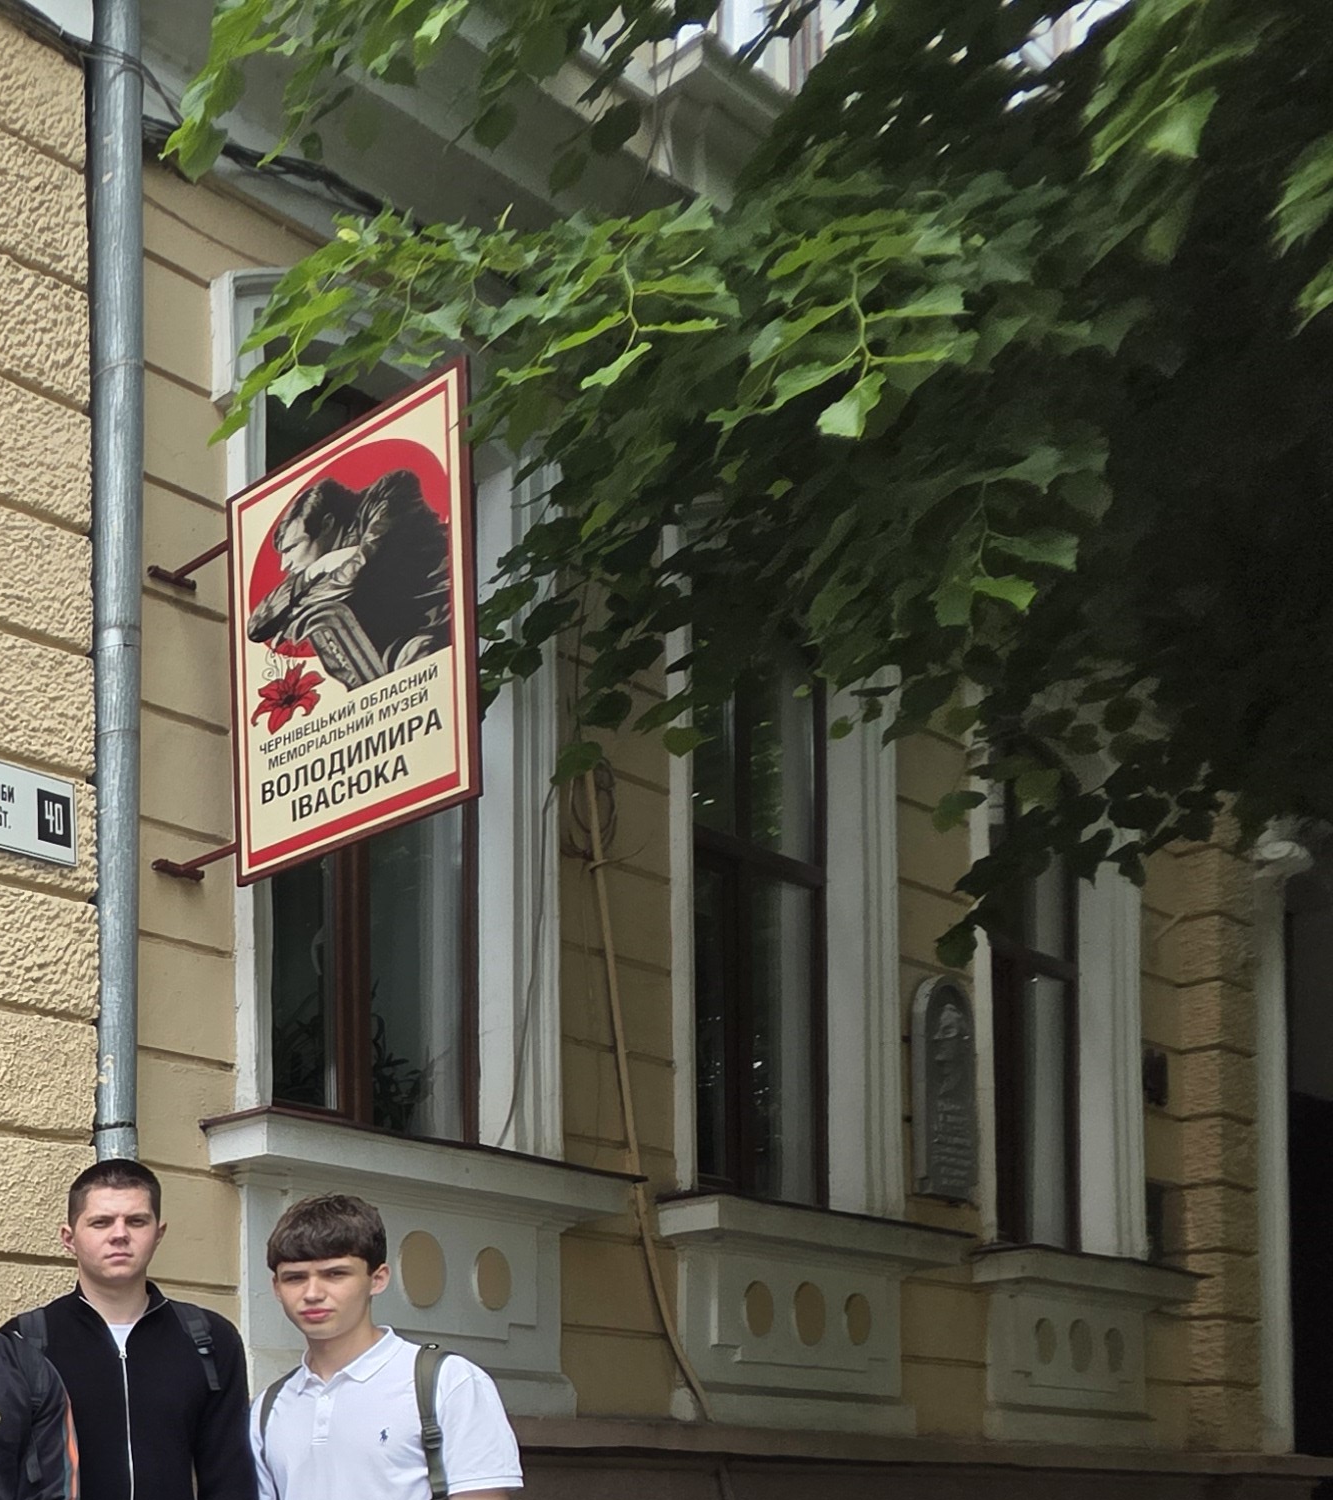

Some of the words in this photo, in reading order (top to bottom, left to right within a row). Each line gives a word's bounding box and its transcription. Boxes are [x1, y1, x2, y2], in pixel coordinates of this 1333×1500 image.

[259, 702, 356, 756] ЧЕРНІВЕЦЬКИЙ
[360, 662, 439, 711] ОБЛАСНИЙ
[268, 709, 374, 771] МЕМОРІАЛЬНИЙ
[378, 688, 429, 722] МУЗЕЙ
[261, 707, 443, 805] ВОЛОДИМИРА
[291, 754, 409, 822] ІВАСЮКА
[44, 800, 64, 836] 40
